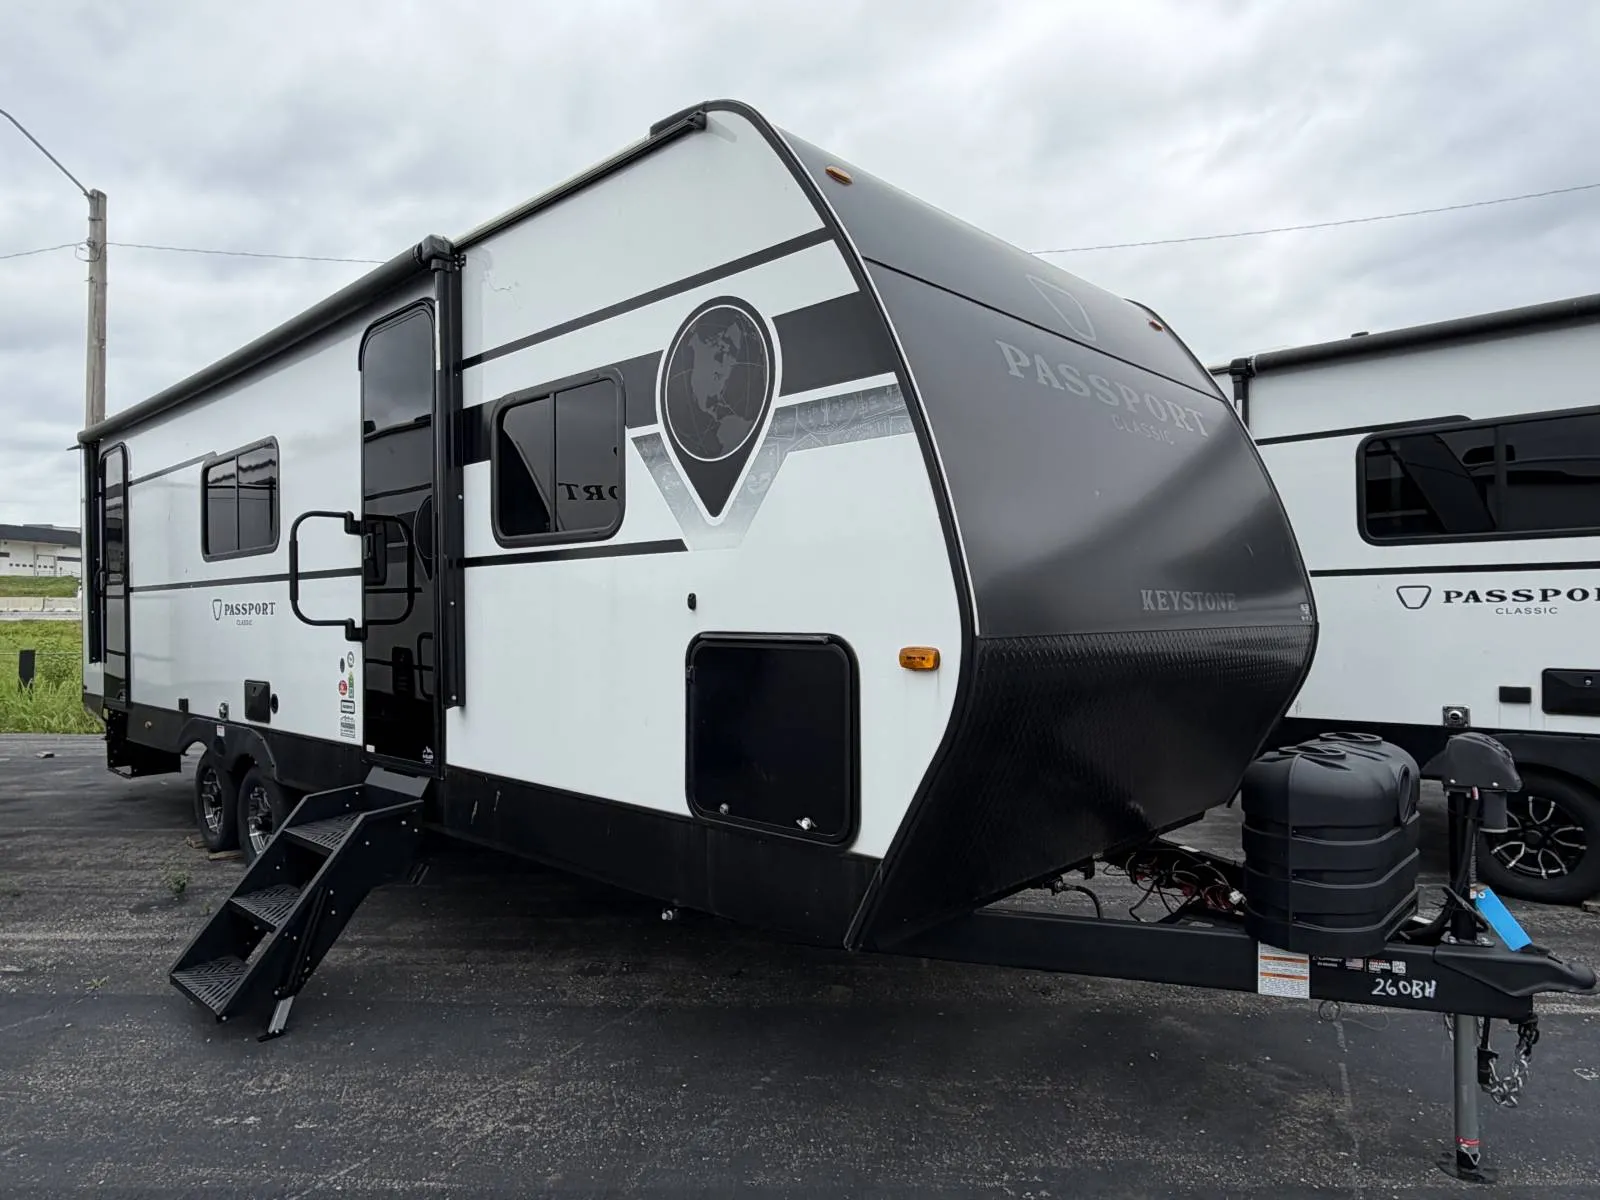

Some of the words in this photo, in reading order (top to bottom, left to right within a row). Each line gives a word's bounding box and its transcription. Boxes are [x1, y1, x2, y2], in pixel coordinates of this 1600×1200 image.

[995, 339, 1209, 438] PASSPORT
[224, 602, 276, 616] PASSPORT
[1140, 588, 1238, 612] KEYSTONE
[1495, 607, 1558, 615] CLASSIC
[1371, 977, 1437, 999] 260BH
